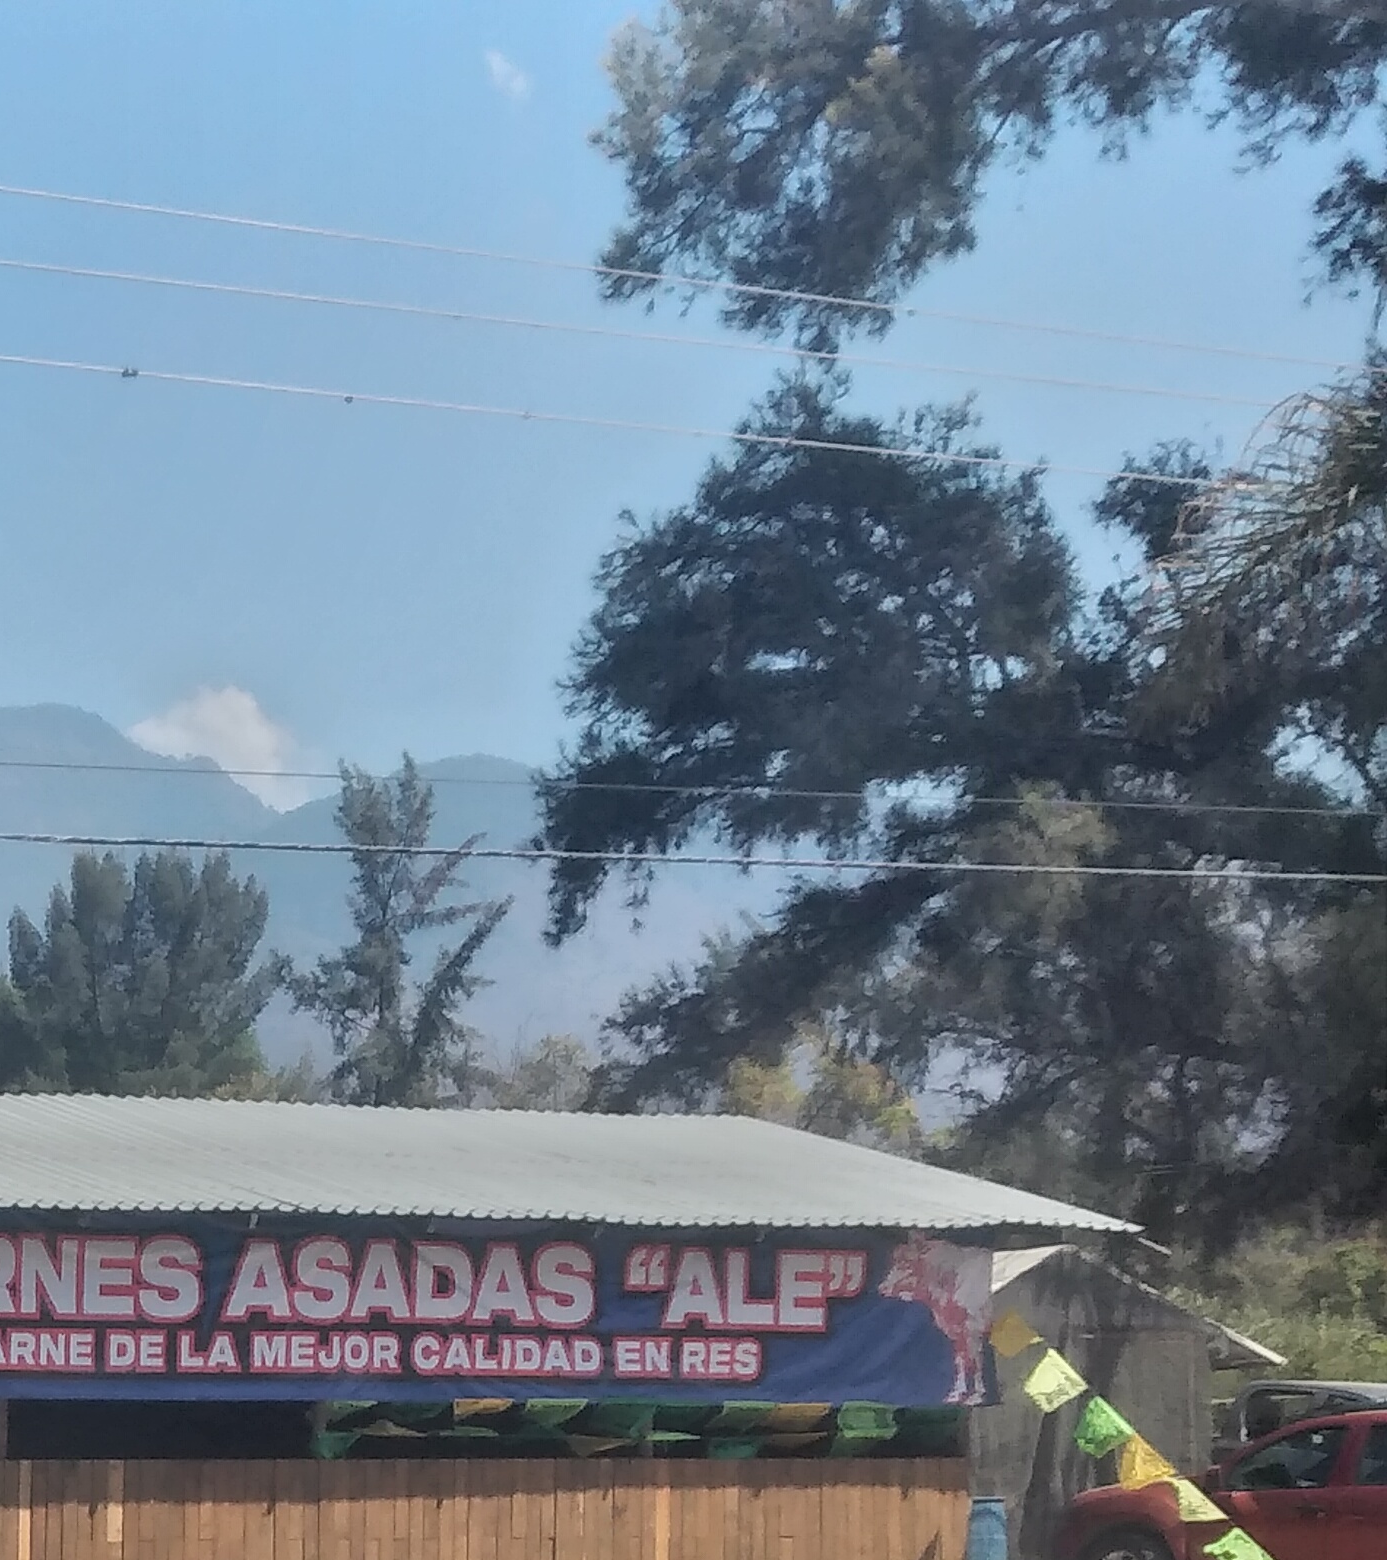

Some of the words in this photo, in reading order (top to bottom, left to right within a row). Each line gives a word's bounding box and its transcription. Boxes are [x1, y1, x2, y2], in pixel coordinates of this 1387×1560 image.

[220, 1236, 596, 1328] ASADAS
[107, 1330, 166, 1371] DE
[178, 1331, 241, 1372] LA
[250, 1332, 401, 1374] MEJOR
[412, 1334, 603, 1376] CALIDAD
[615, 1337, 673, 1378] EN
[681, 1338, 763, 1379] RES
